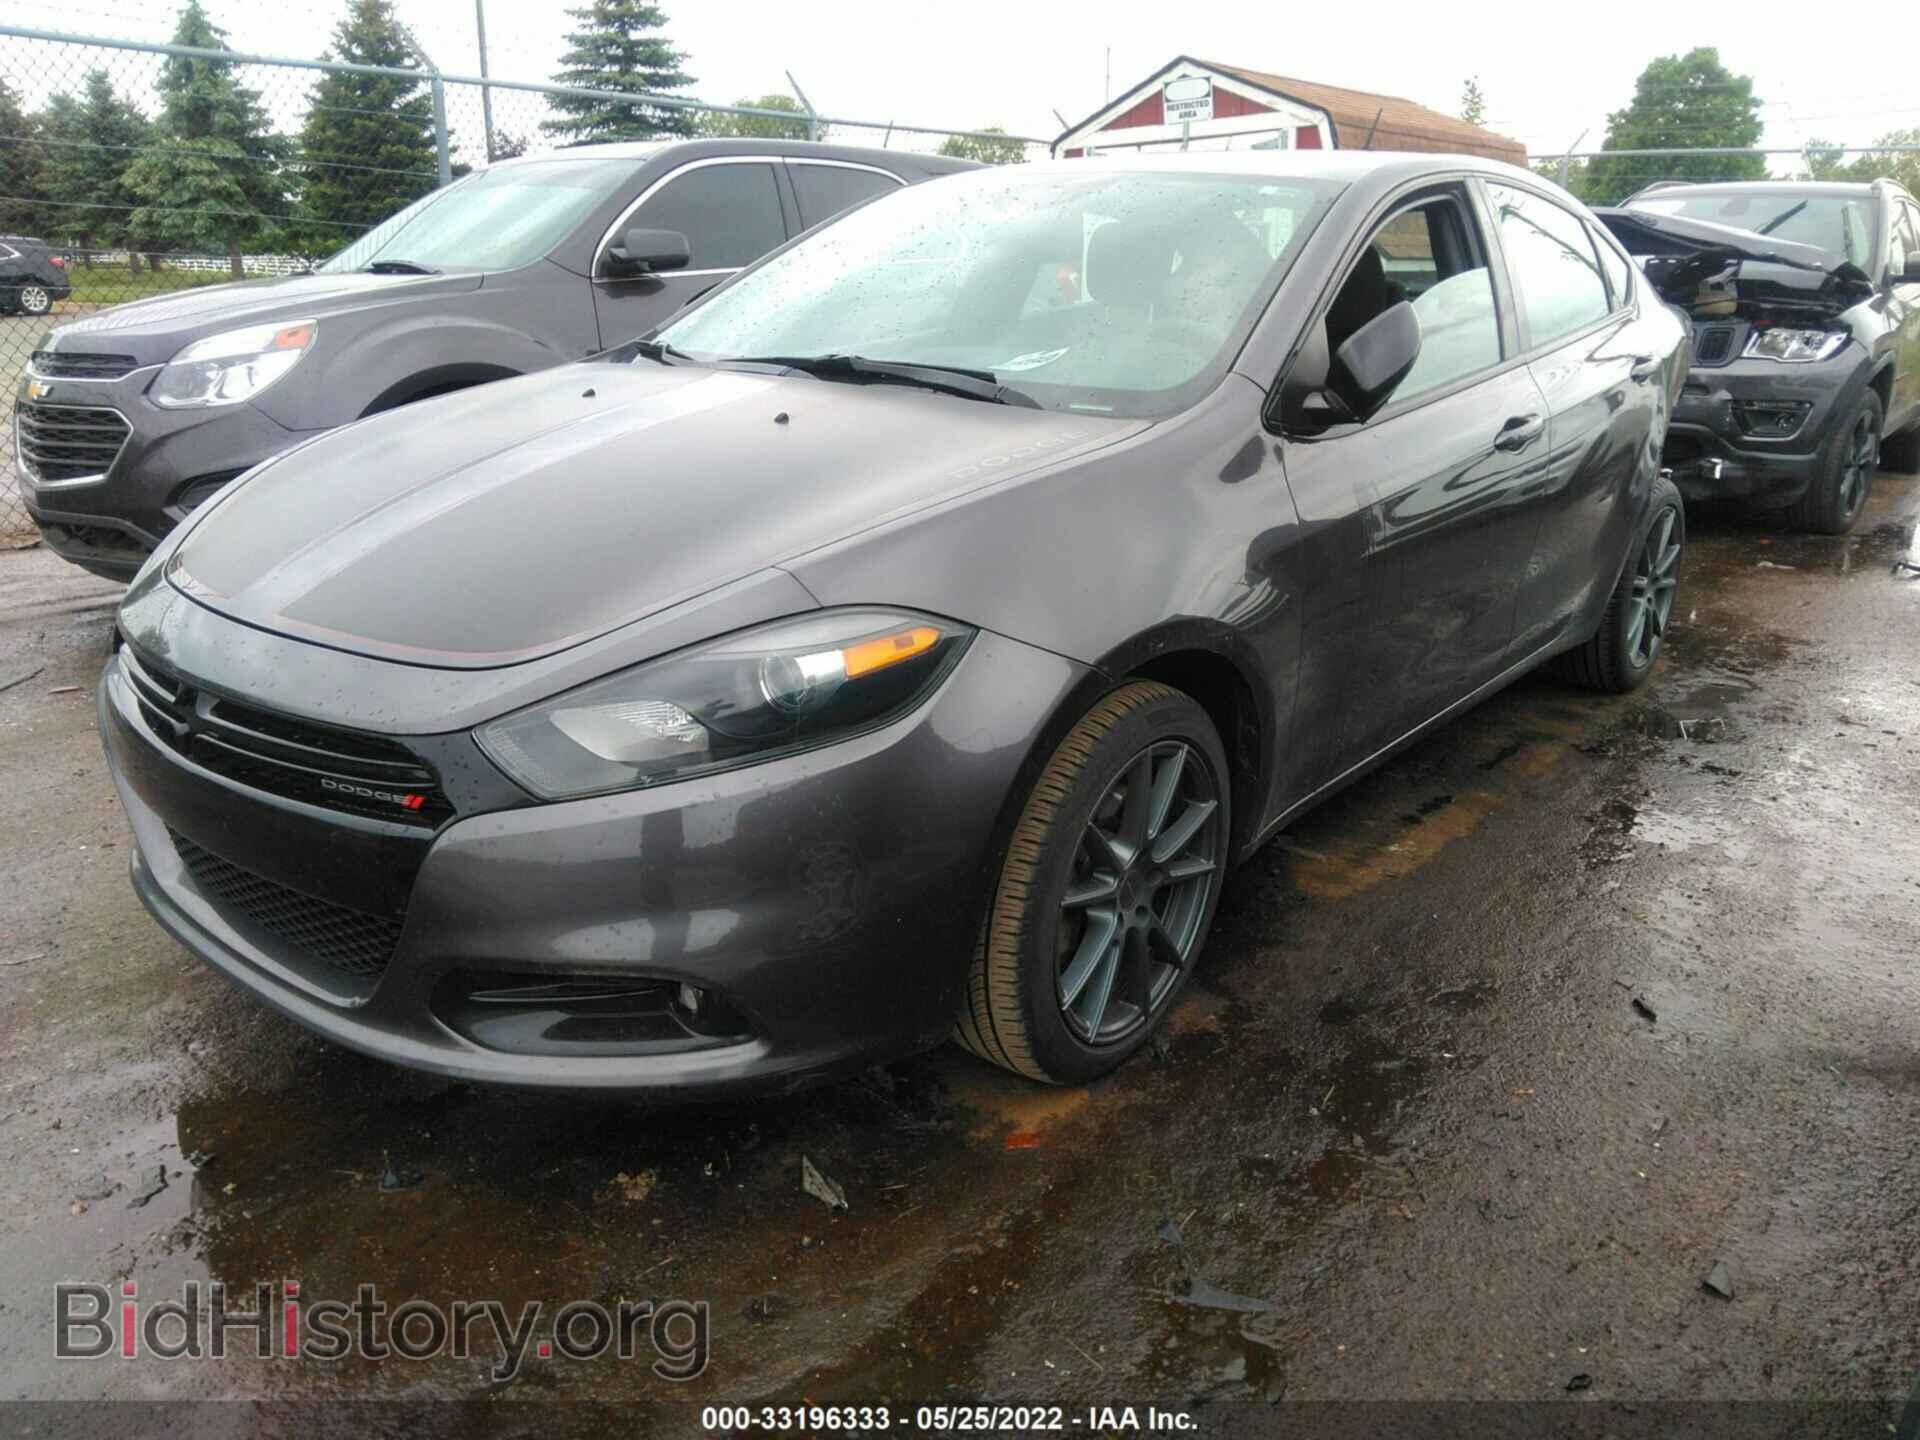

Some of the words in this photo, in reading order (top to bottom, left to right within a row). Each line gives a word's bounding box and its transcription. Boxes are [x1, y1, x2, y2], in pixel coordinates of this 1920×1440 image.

[1167, 100, 1209, 111] RESTRICTED
[1179, 110, 1197, 119] AREA
[321, 779, 408, 807] DODGE
